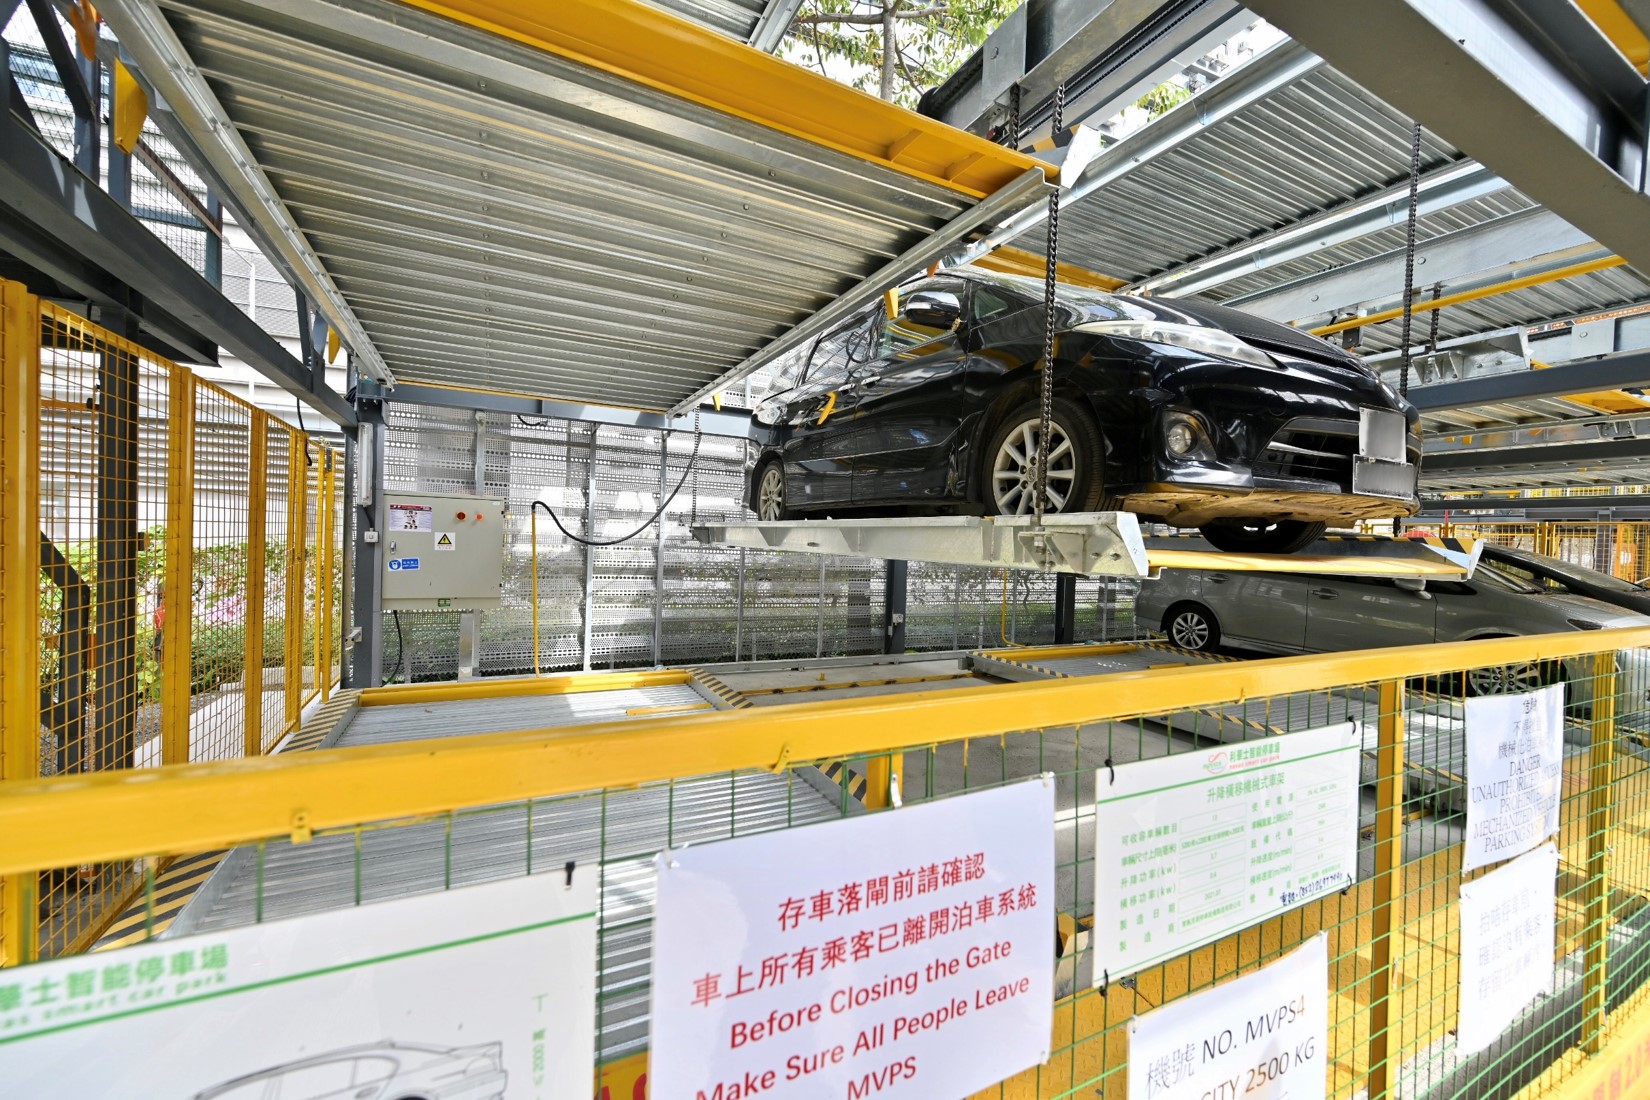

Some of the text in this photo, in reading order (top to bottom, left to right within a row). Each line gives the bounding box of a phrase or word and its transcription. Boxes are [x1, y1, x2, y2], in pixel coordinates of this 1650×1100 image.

[1472, 772, 1541, 804] UNAUTHORIZED
[1509, 753, 1541, 776] DANGER
[1473, 808, 1534, 839] MECHANIZED
[1484, 828, 1524, 853] PARKING
[778, 852, 985, 932] 存車落閘前請確認
[690, 882, 1037, 1008] 車上所有乘客已離開泊車系統
[43, 994, 118, 1021] smart
[128, 983, 166, 1003] car
[175, 972, 227, 996] park
[729, 939, 1012, 1050] Before Closing the Gate
[696, 974, 1030, 1100] Make Sure All People Leave
[1202, 1028, 1238, 1064] NO.
[1245, 994, 1306, 1045] MVPS4
[847, 1055, 918, 1100] MVPS
[1245, 1051, 1290, 1094] 2500
[1294, 1035, 1316, 1068] KG
